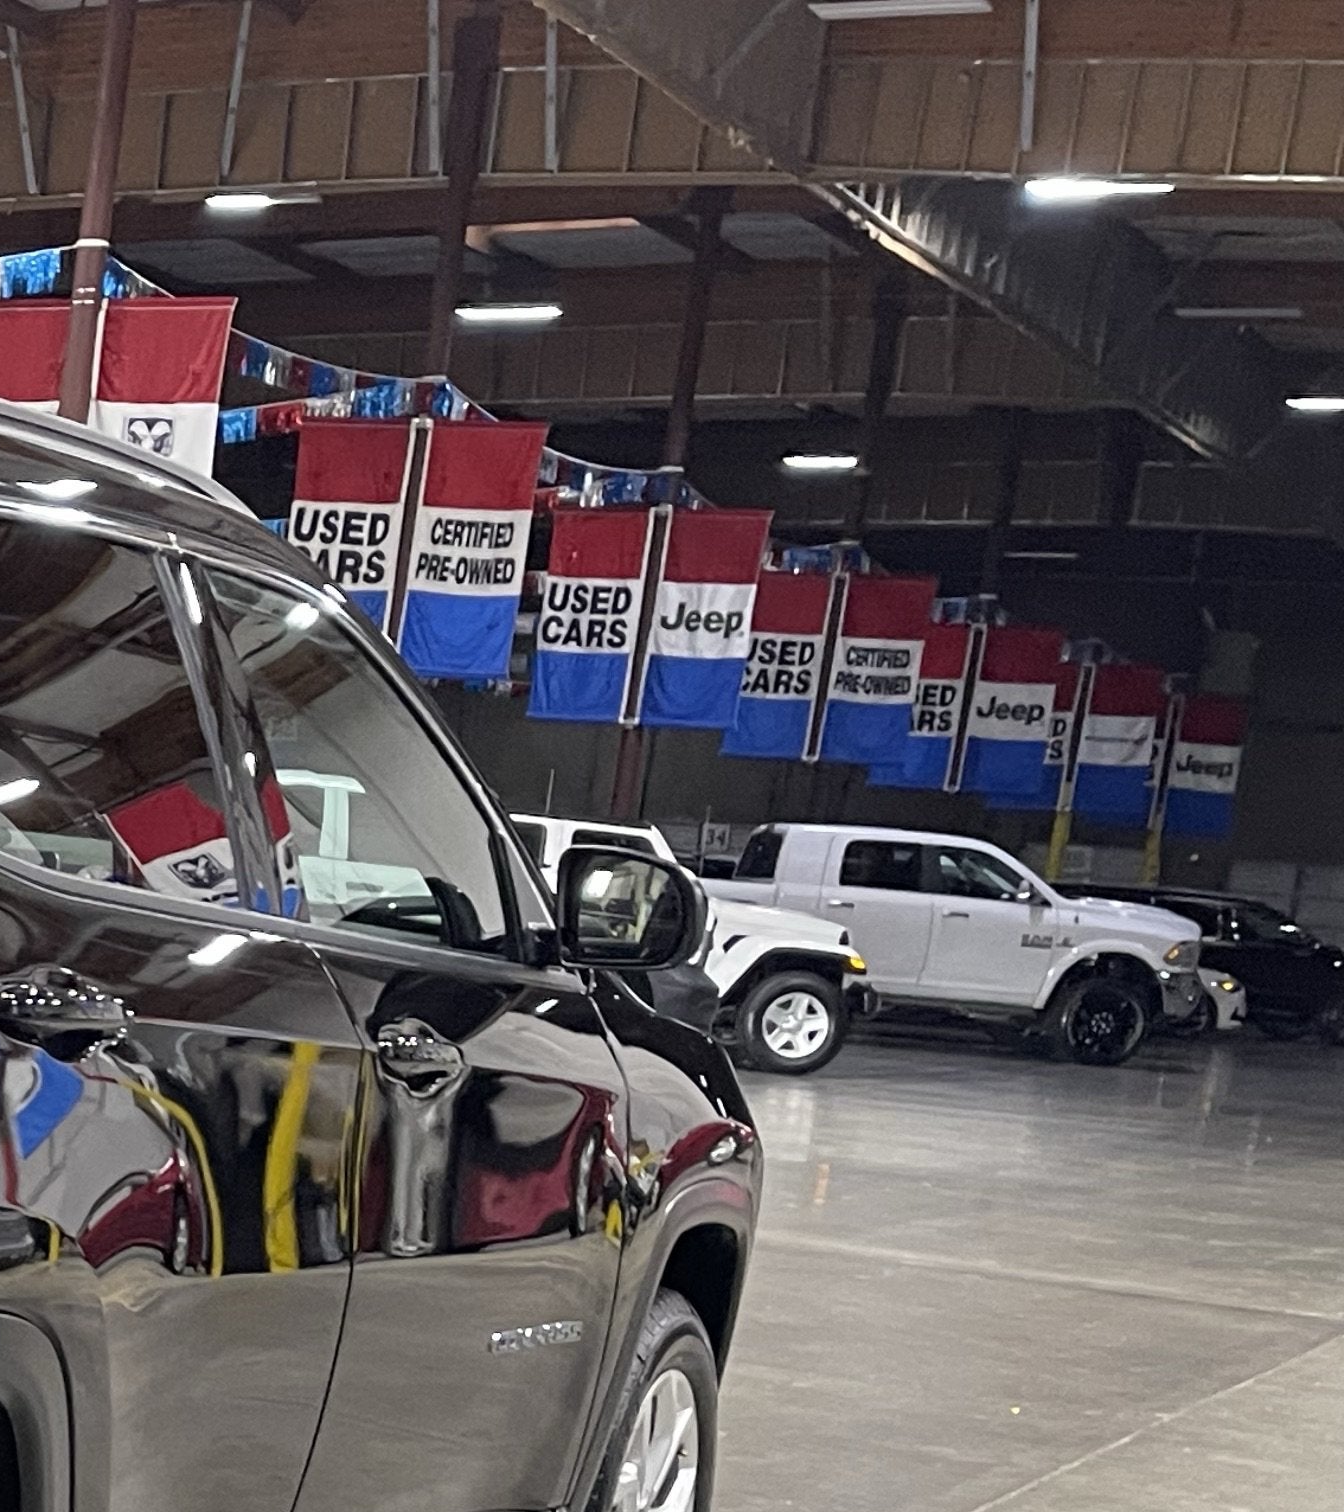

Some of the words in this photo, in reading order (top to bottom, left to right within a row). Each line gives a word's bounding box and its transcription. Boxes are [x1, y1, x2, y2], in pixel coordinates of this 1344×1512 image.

[293, 507, 391, 546] USED
[430, 517, 515, 549] CERTIFIED
[298, 546, 386, 584] ARS
[415, 553, 516, 585] PRE-OWNED
[547, 583, 633, 616] USED
[541, 615, 629, 649] CARS
[660, 602, 745, 639] Jeep
[975, 696, 1046, 726] Jeep
